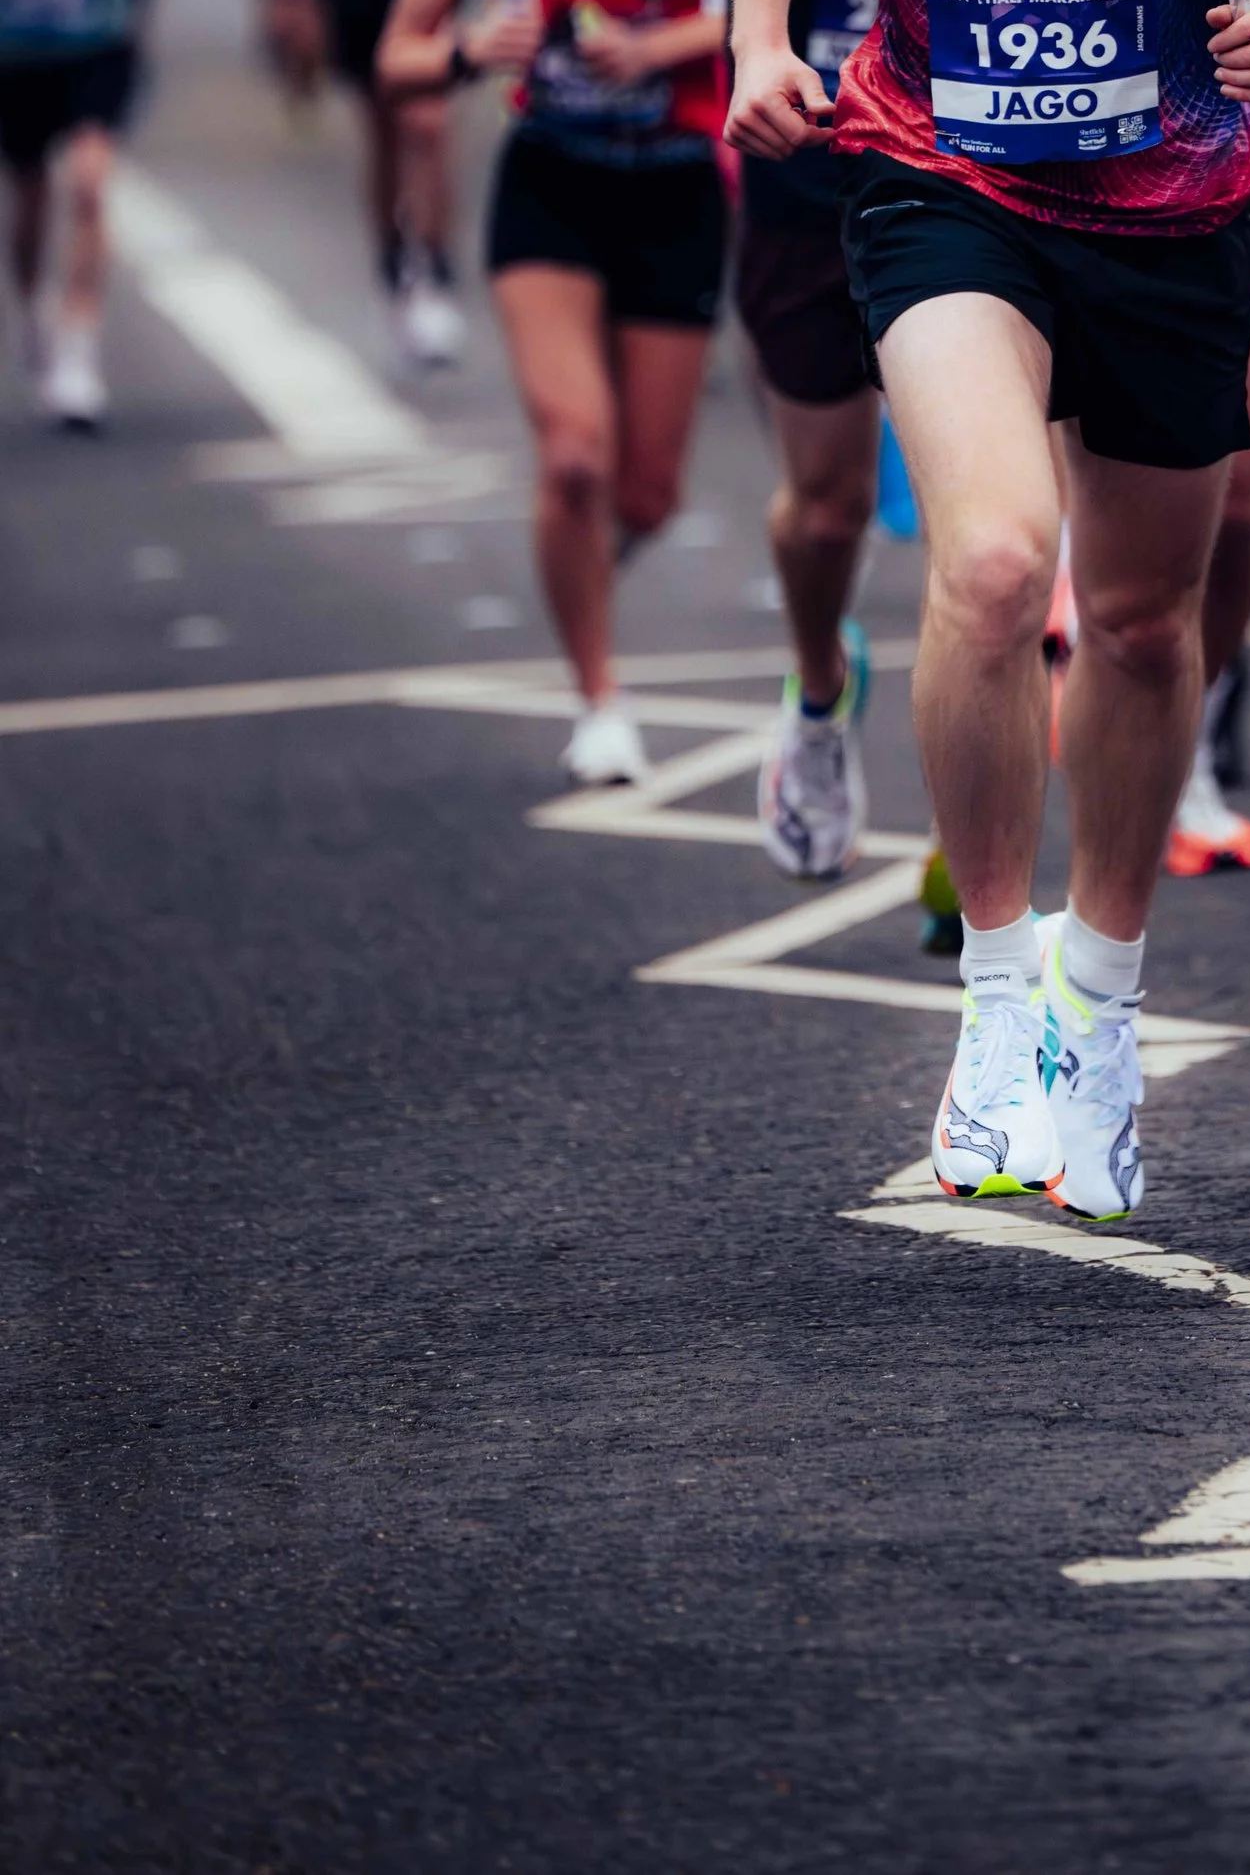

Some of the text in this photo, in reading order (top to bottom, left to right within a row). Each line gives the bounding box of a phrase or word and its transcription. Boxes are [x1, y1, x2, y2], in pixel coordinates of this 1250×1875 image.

[970, 19, 1117, 70] 1936
[1136, 32, 1144, 51] JAGO
[985, 88, 1098, 121] JAGO
[976, 145, 991, 153] FOR
[992, 146, 1006, 154] ALL
[974, 973, 1010, 983] saucony
